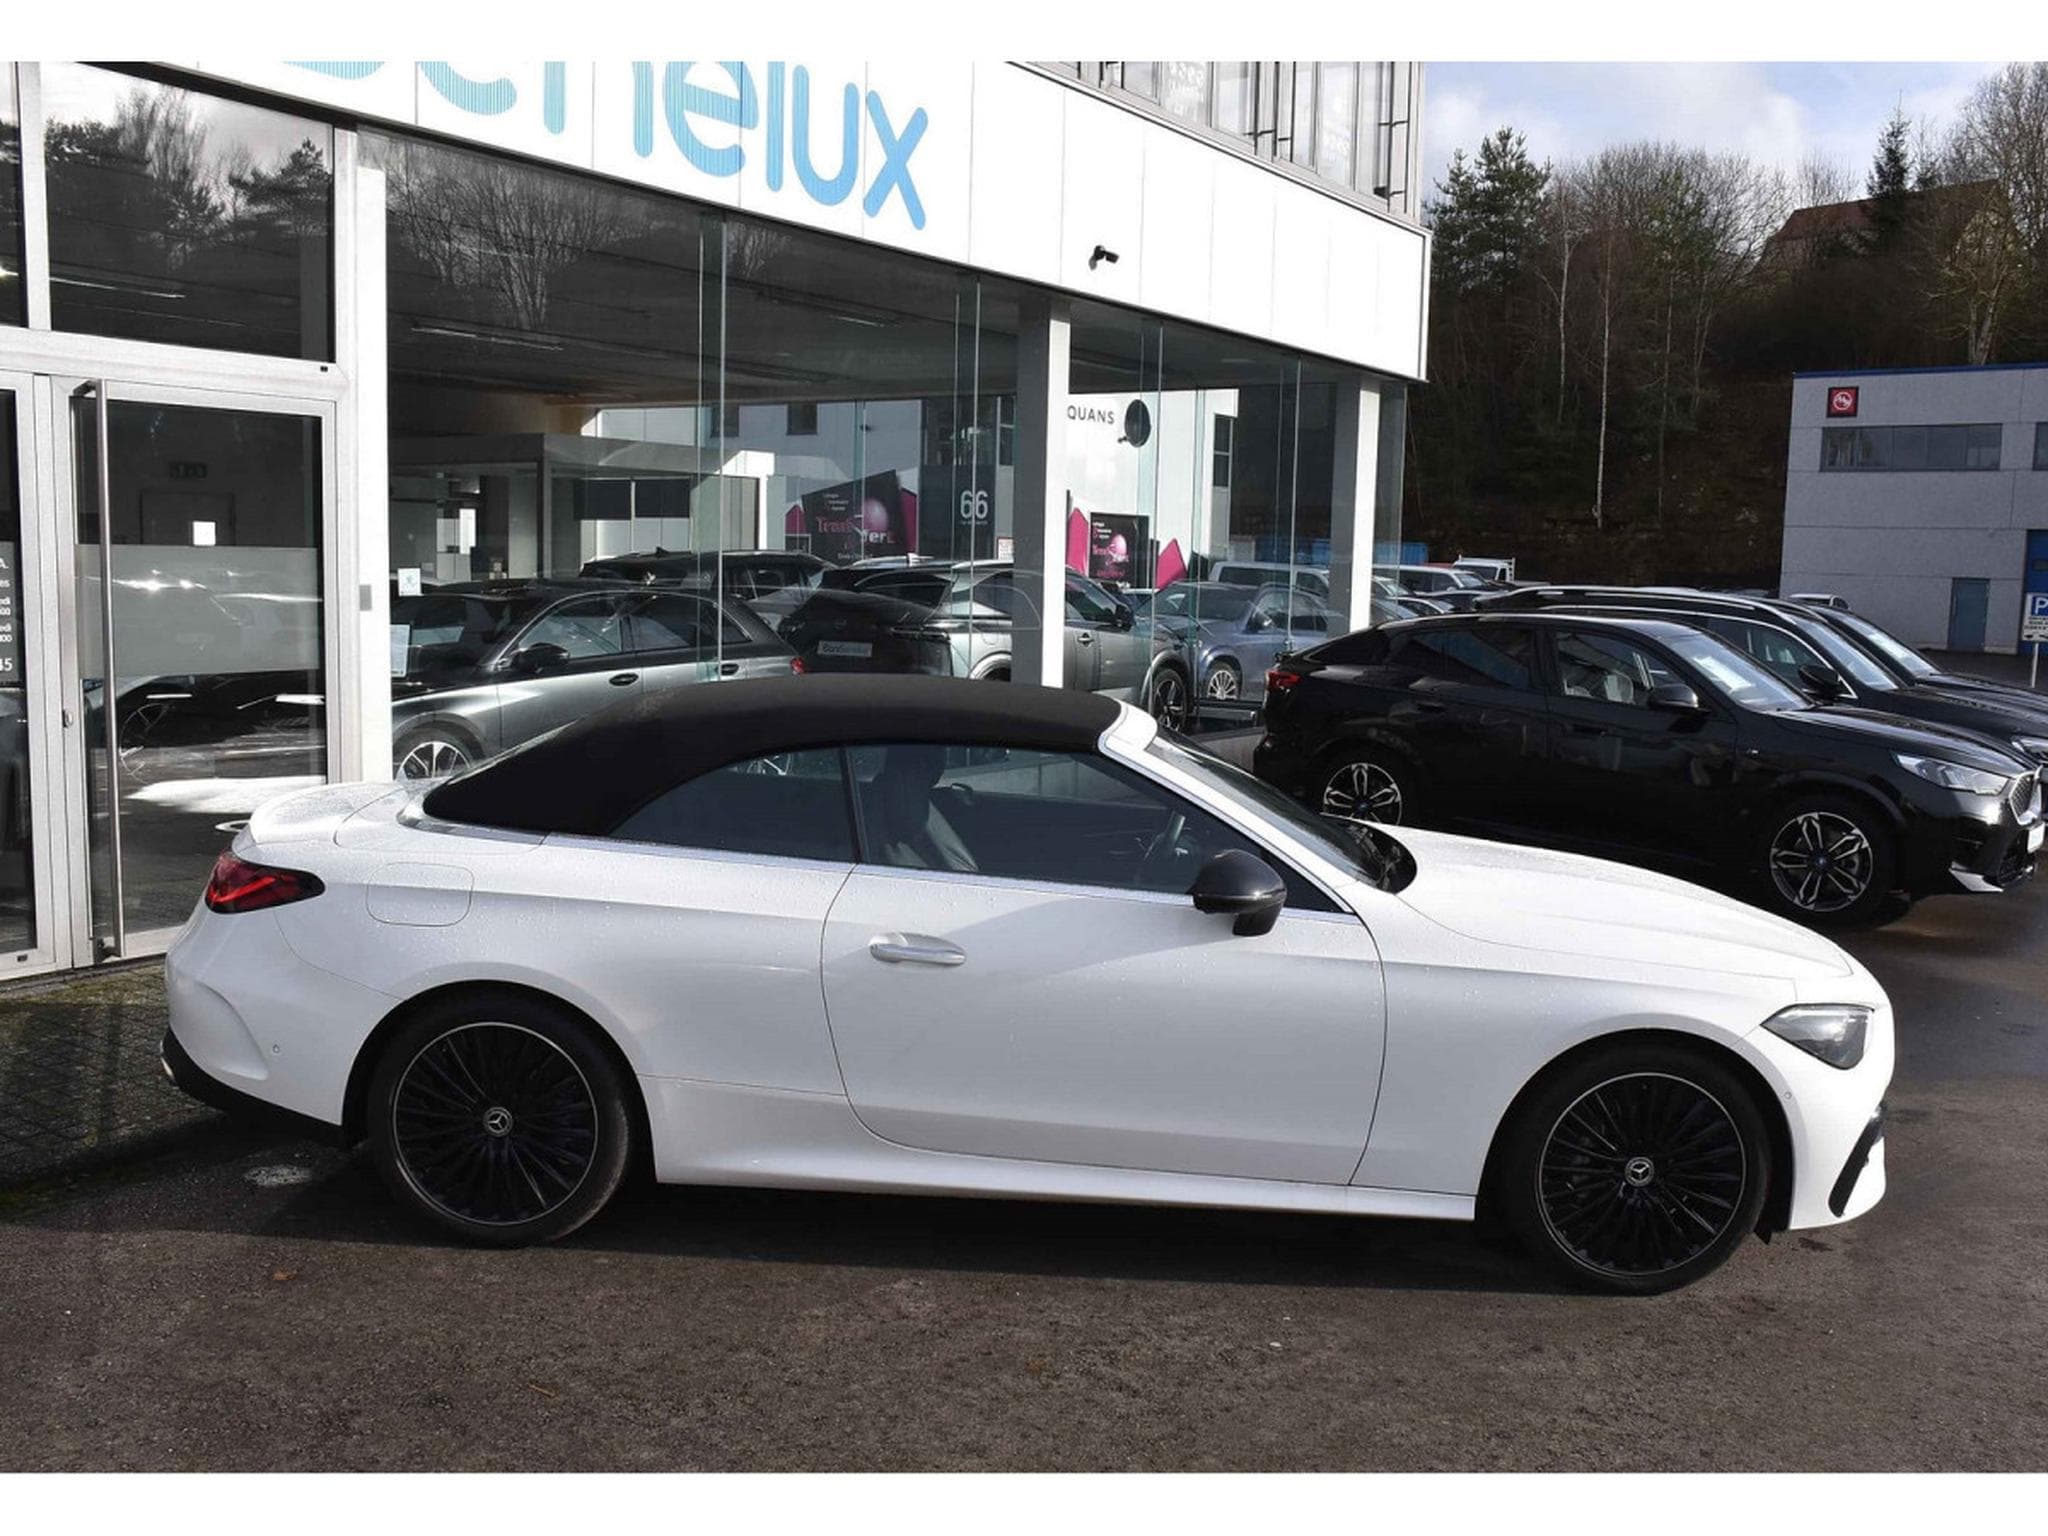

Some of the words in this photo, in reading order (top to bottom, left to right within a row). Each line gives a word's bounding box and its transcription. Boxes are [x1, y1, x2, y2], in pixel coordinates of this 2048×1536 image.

[282, 61, 929, 230] nelux
[1067, 405, 1115, 425] QUANS
[960, 490, 988, 519] 66
[2035, 597, 2048, 614] P
